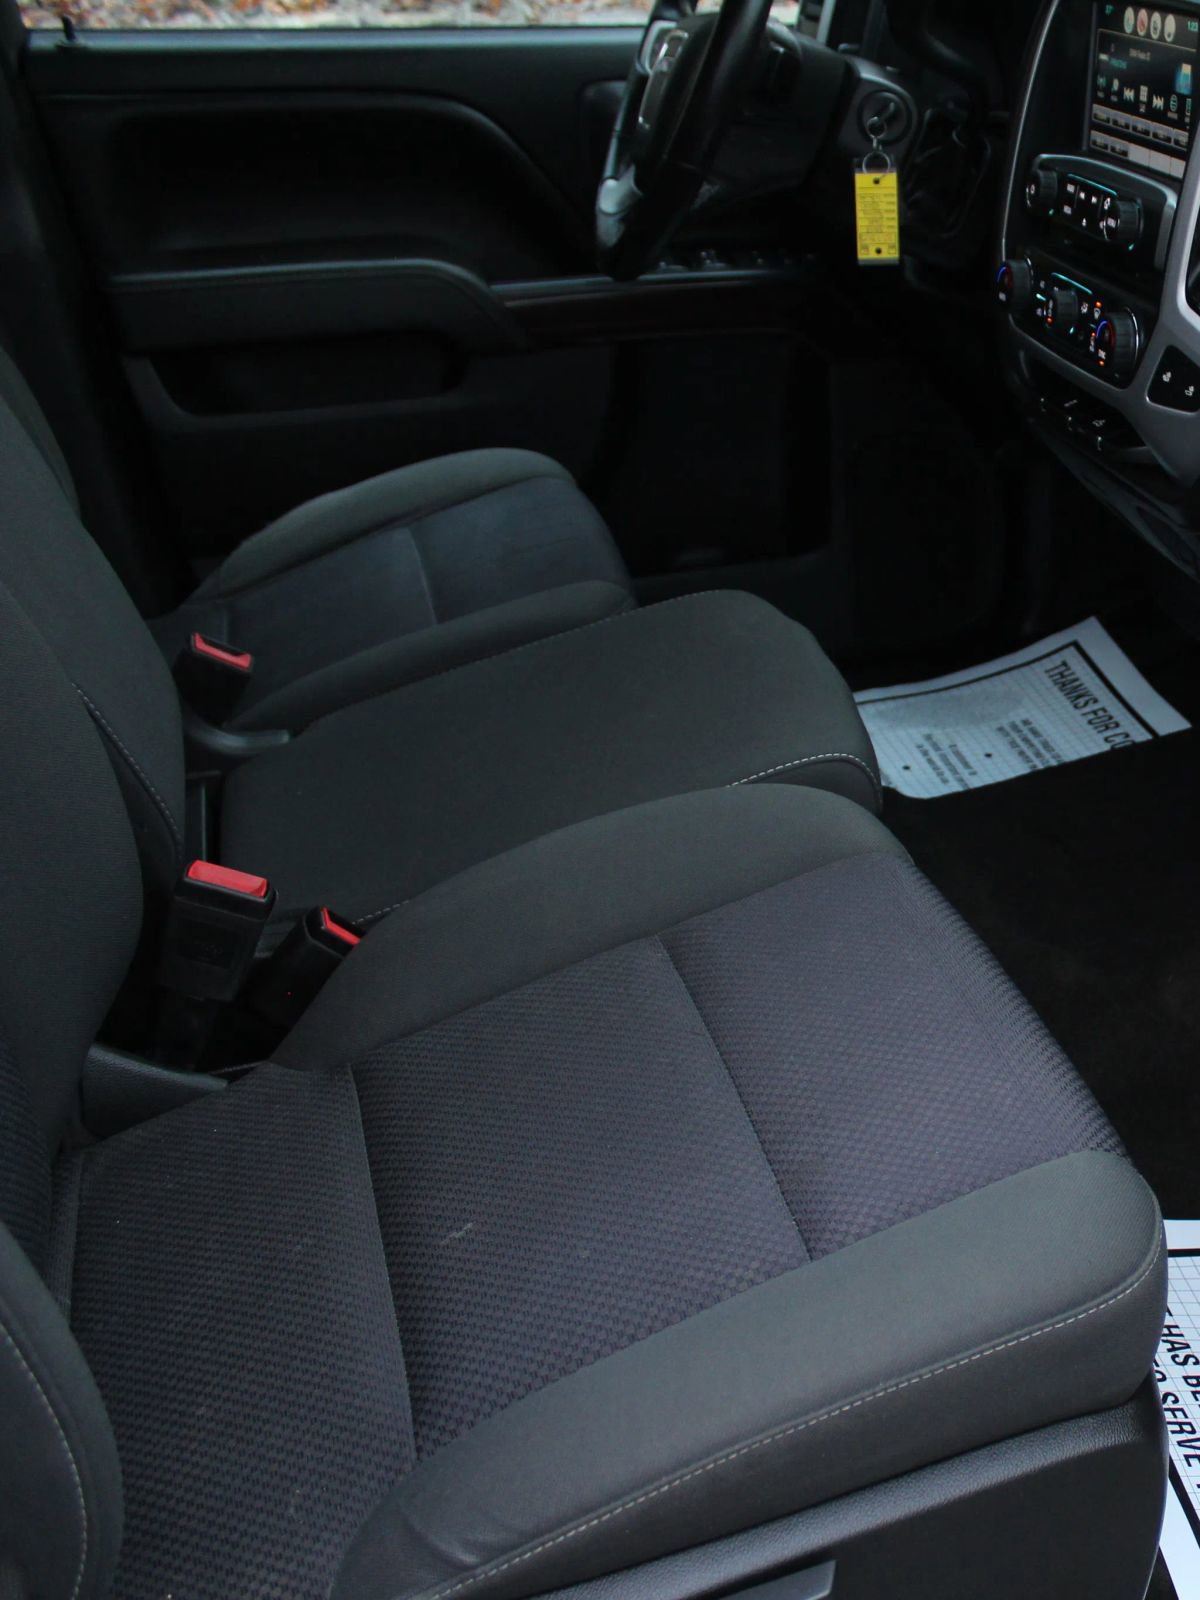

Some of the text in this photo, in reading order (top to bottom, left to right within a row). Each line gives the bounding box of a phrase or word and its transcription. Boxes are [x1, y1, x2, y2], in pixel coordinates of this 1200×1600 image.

[1044, 660, 1099, 710] THANKS
[1081, 706, 1120, 734] FOR
[1160, 1324, 1200, 1367] HAS
